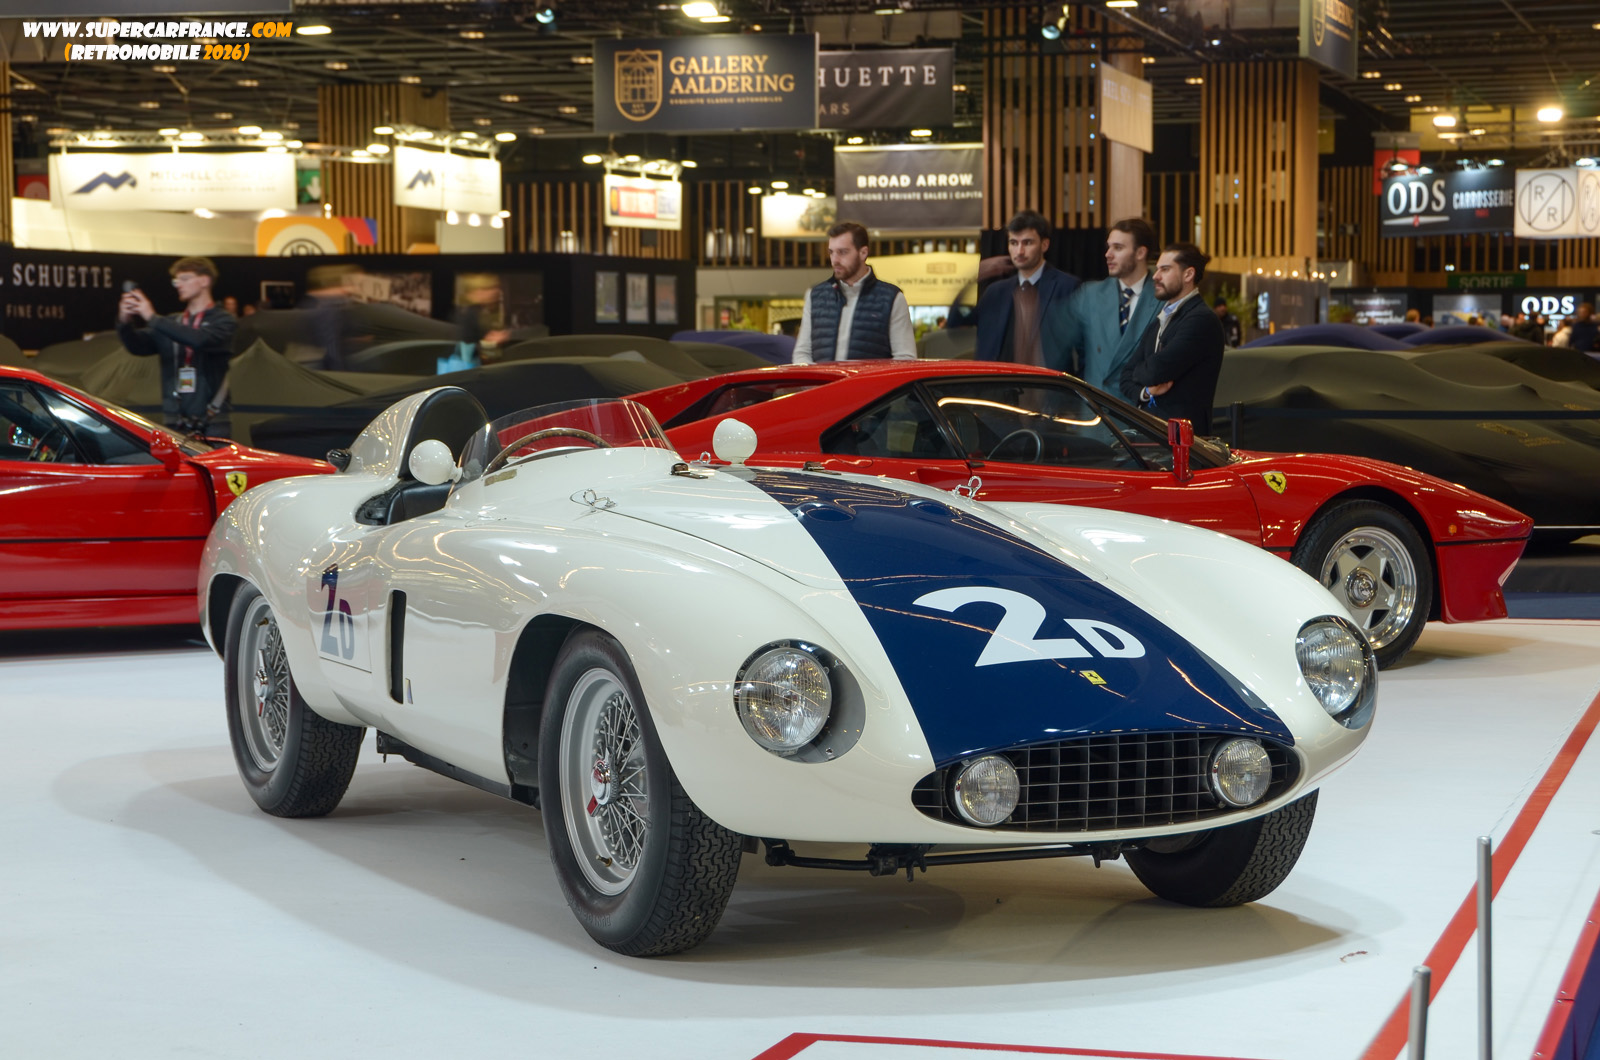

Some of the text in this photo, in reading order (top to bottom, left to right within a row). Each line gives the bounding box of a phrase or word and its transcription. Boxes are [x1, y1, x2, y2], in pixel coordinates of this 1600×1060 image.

[669, 55, 768, 76] GALLERY
[669, 73, 795, 95] AALDERING
[857, 173, 973, 188] BROAD ARROW
[843, 193, 882, 202] AUCTIONS
[889, 192, 921, 201] PRIVATE
[923, 192, 948, 200] SALES
[1387, 179, 1514, 215] ODS CARROSSERIE
[12, 263, 113, 289] SCHUETTE
[6, 303, 66, 319] FINE CARS
[1521, 295, 1575, 316] ODS
[912, 586, 1146, 668] 2D
